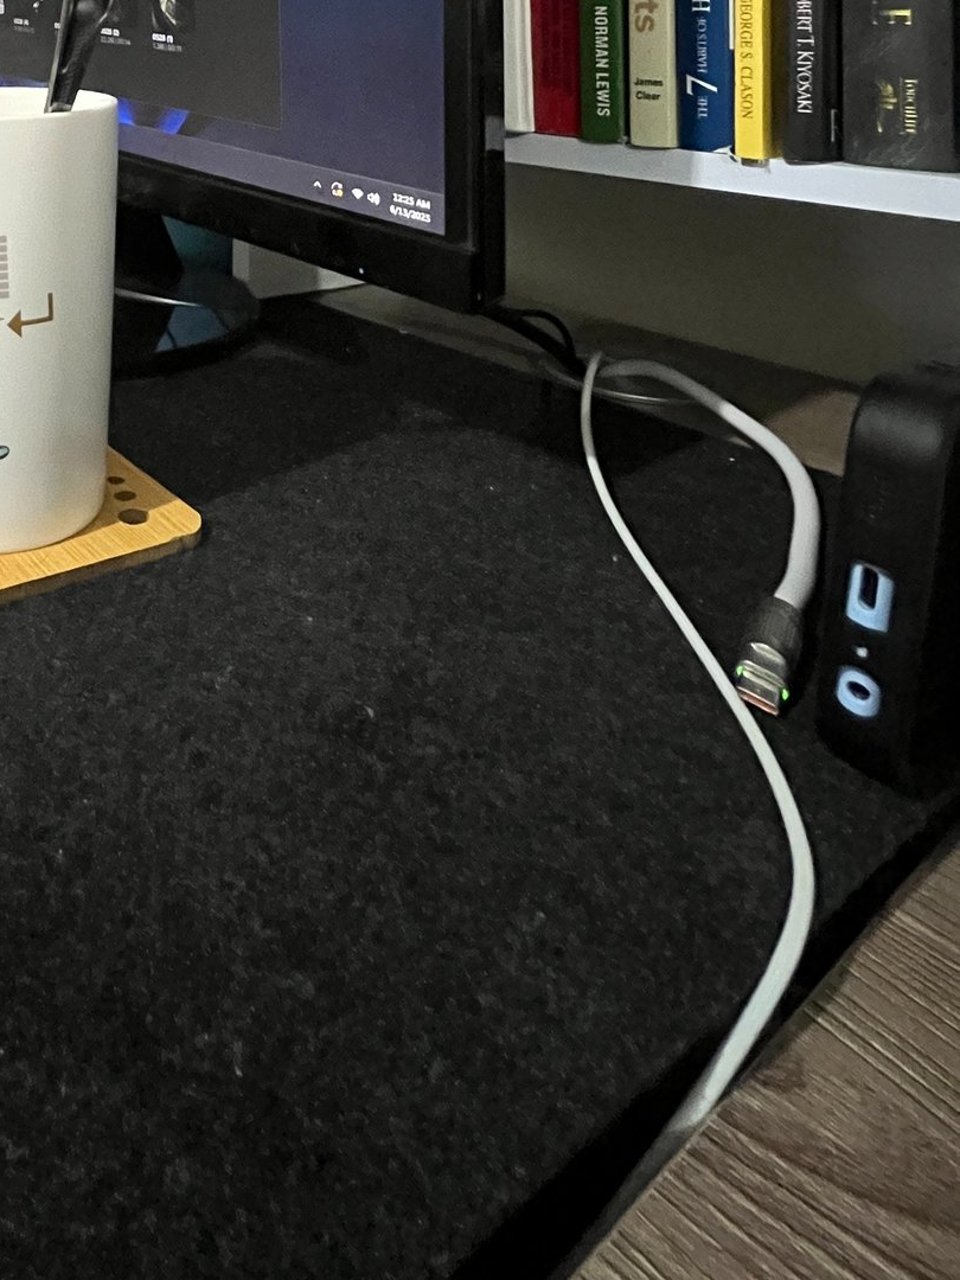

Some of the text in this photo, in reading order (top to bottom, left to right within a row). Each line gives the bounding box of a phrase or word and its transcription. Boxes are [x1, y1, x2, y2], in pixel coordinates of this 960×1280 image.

[697, 16, 707, 32] OF
[796, 34, 815, 47] T.
[594, 5, 611, 117] NORMAN LEWIS
[697, 33, 708, 74] HABITS
[634, 77, 663, 88] James
[686, 73, 718, 96] 7
[740, 66, 755, 120] CLASON
[796, 50, 815, 114] KIYOSAKI
[635, 91, 661, 101] Clear
[697, 95, 708, 118] THE
[416, 198, 431, 209] AM
